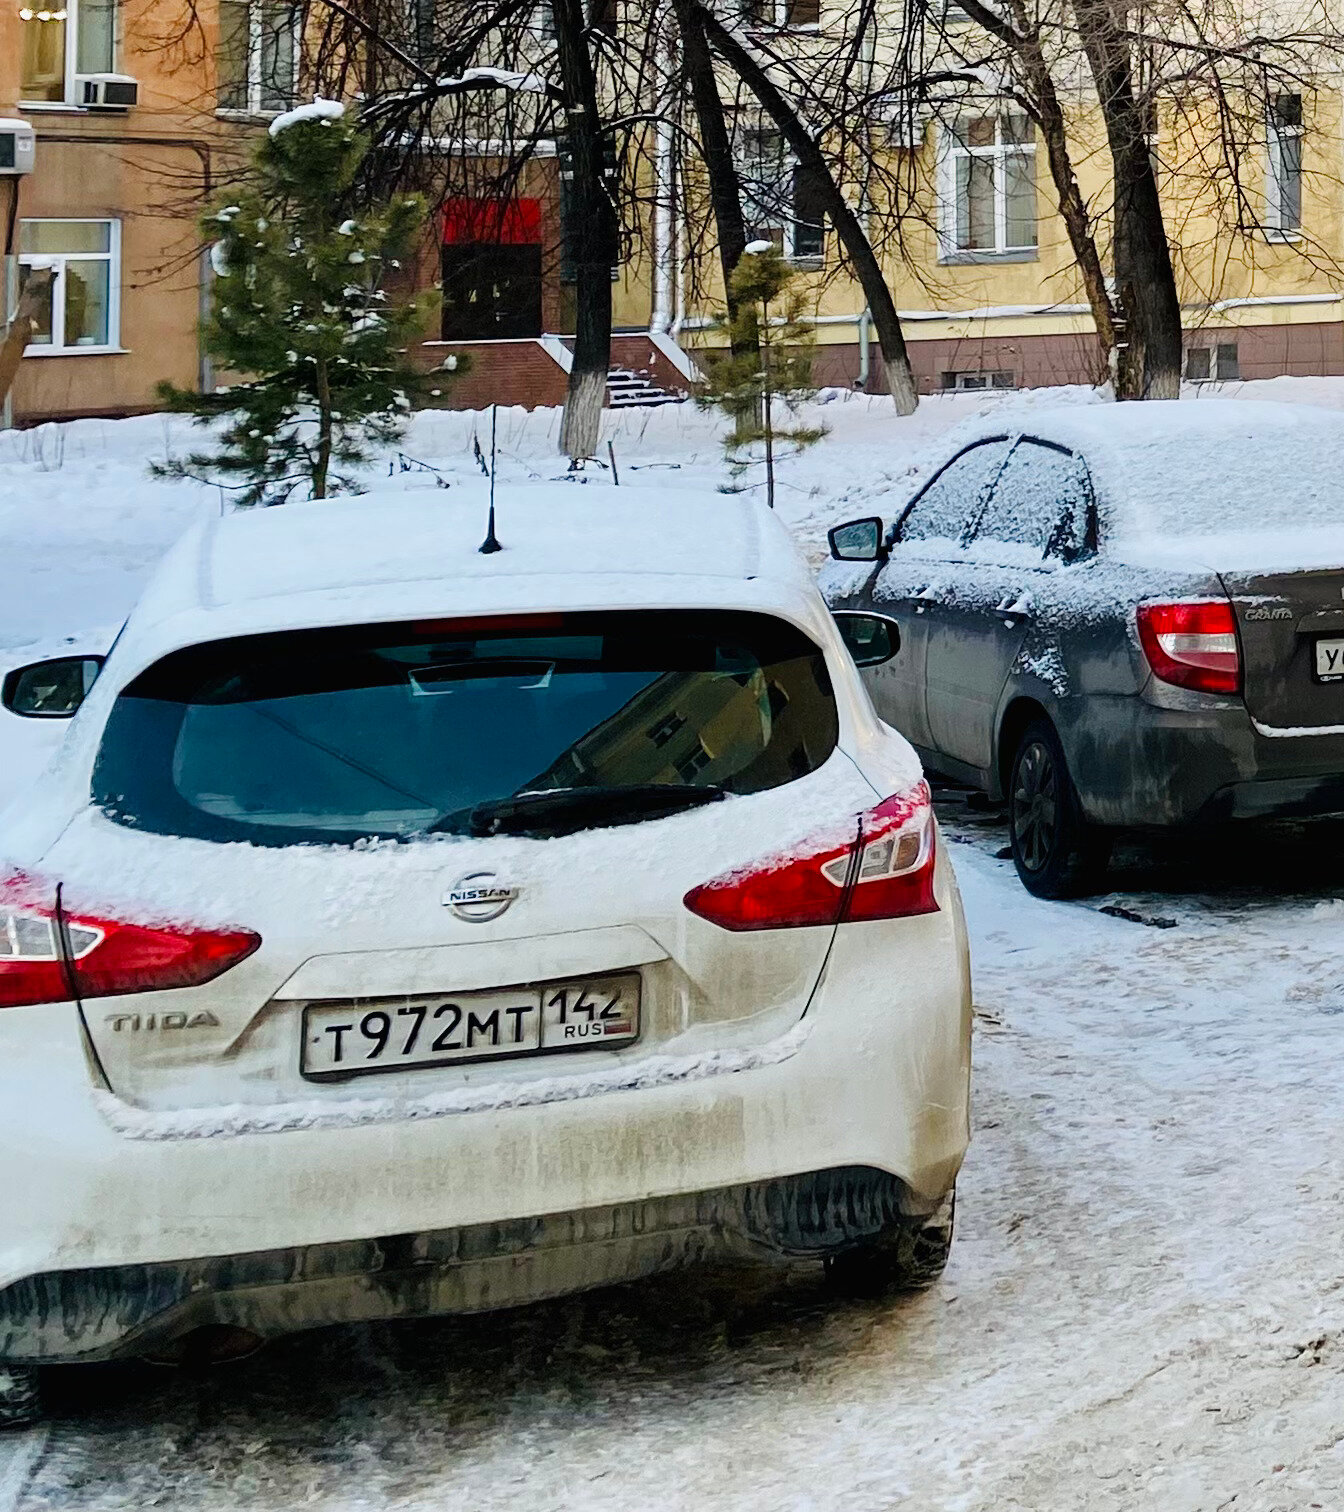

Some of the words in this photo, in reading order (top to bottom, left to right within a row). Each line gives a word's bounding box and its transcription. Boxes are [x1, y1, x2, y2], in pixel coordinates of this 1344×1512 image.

[1244, 606, 1293, 621] GRANTA
[449, 888, 511, 901] NISSAN
[104, 1009, 220, 1032] TIIDA
[324, 1005, 535, 1064] Т972МТ
[548, 986, 624, 1025] 142
[563, 1020, 605, 1040] RUS
